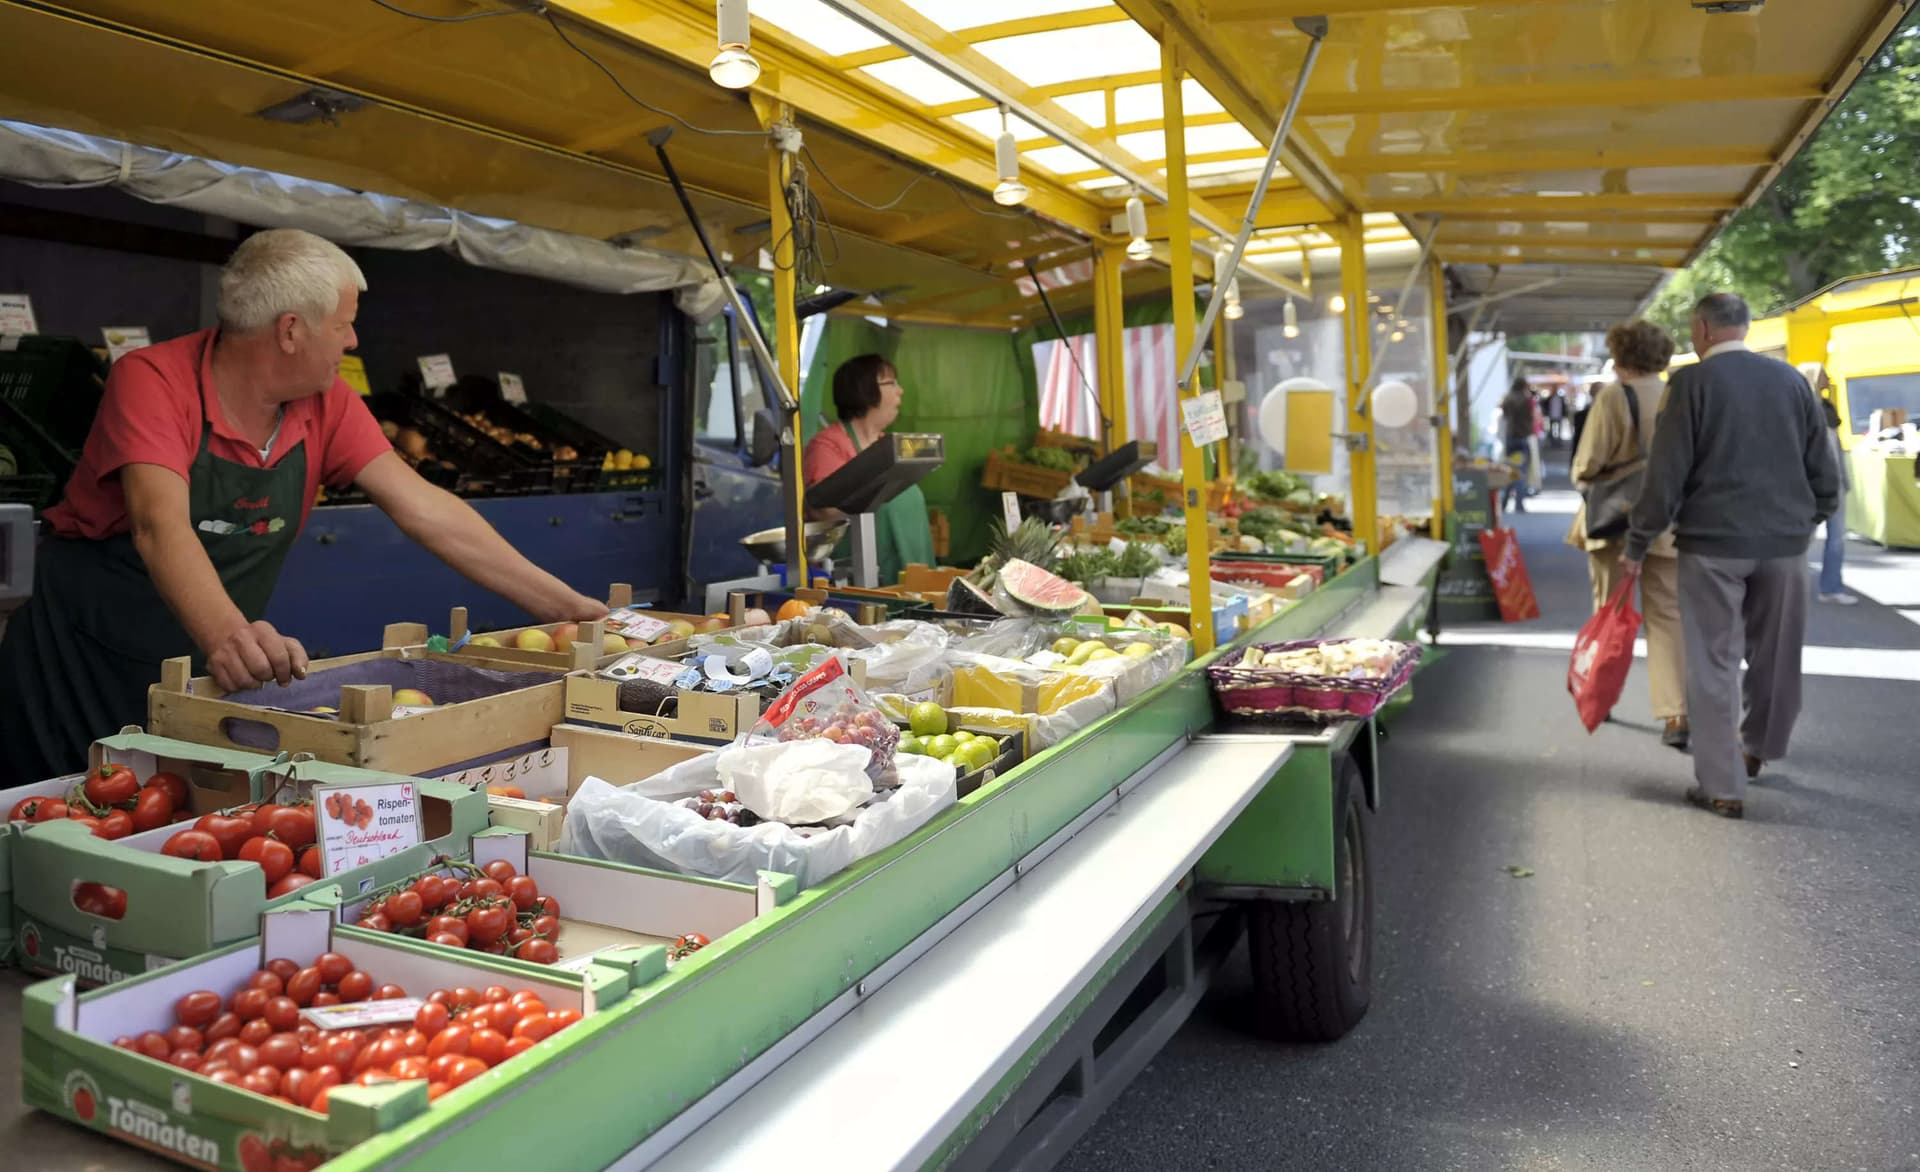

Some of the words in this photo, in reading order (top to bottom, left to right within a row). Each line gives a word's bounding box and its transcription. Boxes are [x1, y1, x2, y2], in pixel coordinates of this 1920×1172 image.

[377, 799, 411, 811] Rispen-
[379, 814, 414, 826] tomaten
[107, 1096, 219, 1163] Tomaten
